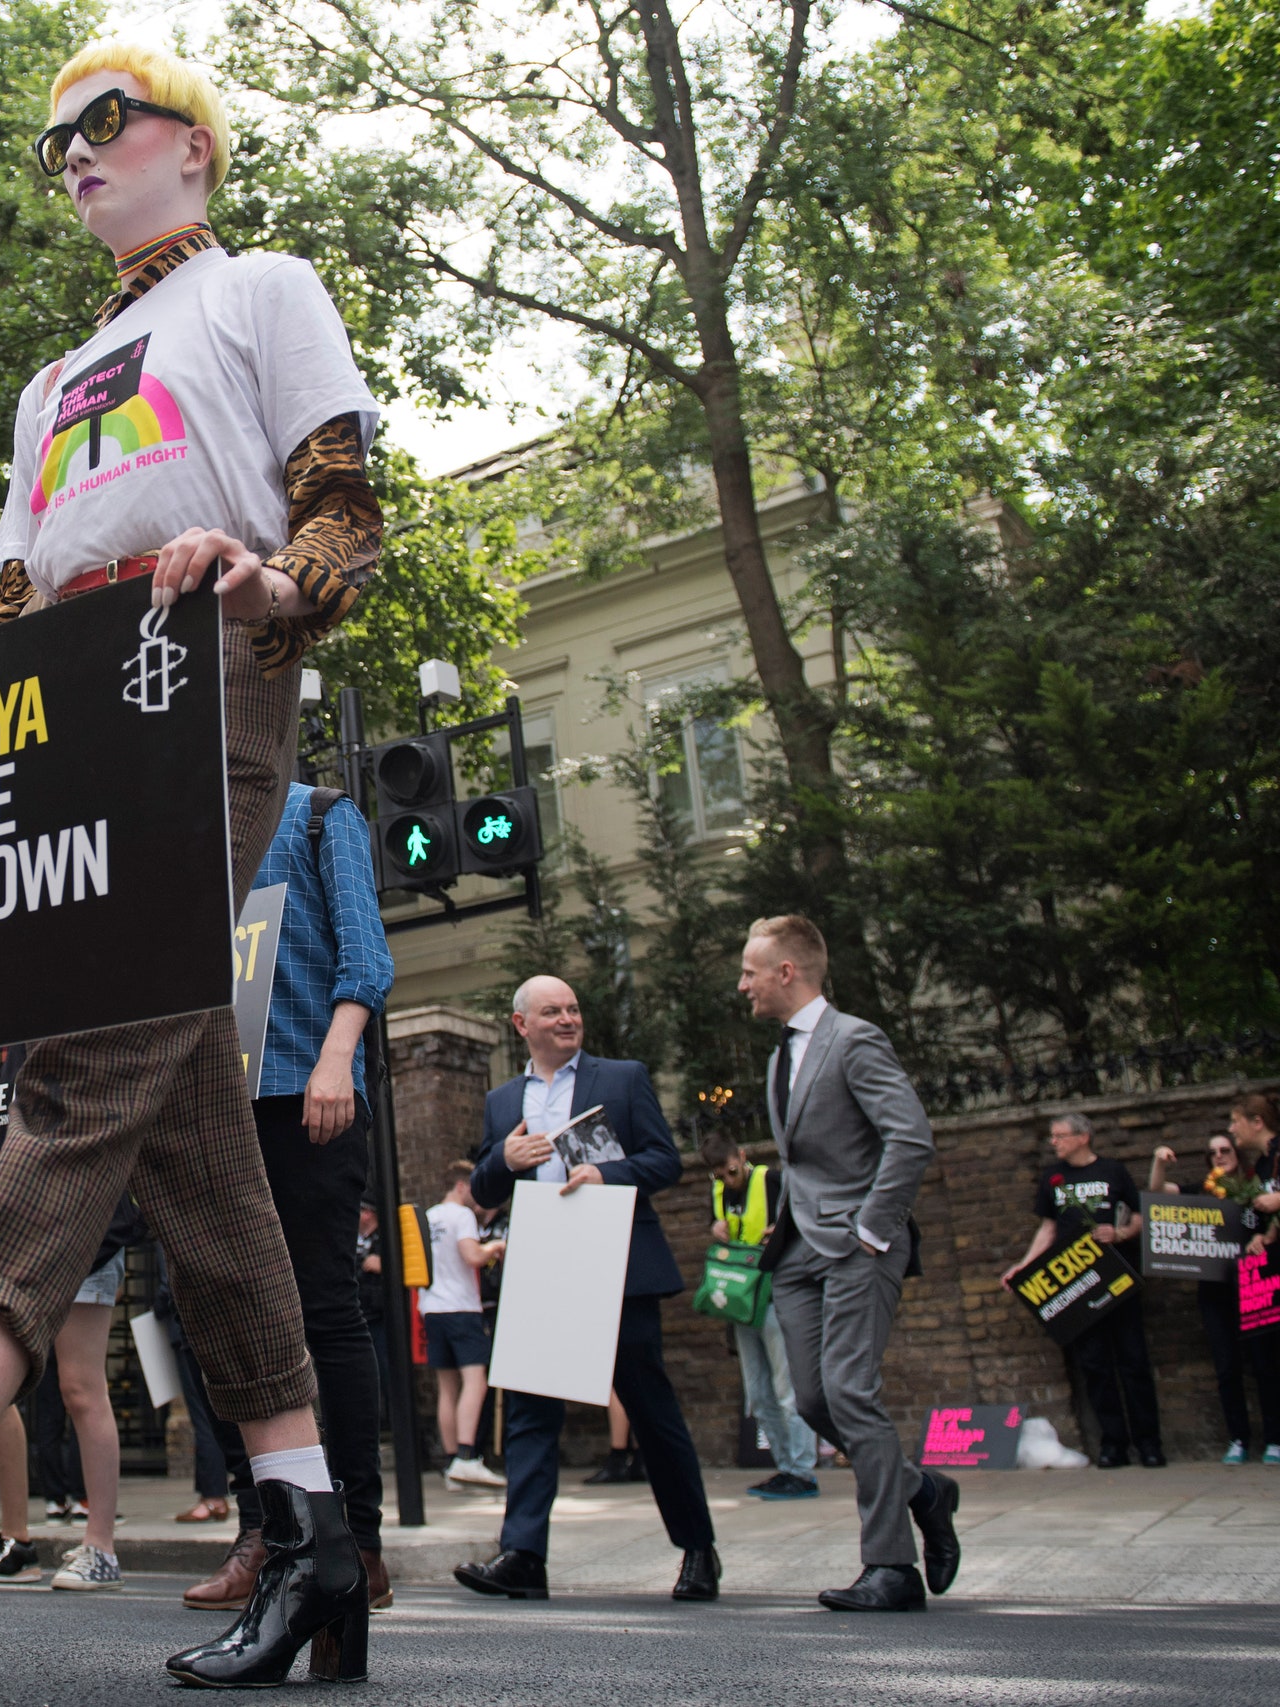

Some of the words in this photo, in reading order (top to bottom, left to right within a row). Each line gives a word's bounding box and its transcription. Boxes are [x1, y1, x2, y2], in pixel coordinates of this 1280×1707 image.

[63, 362, 126, 403] PROTECT
[58, 390, 108, 423] HUMAN
[62, 390, 86, 412] THE
[55, 493, 65, 509] IS
[67, 487, 76, 501] A
[79, 460, 131, 493] HUMAN
[135, 445, 188, 469] RIGHT
[1149, 1204, 1225, 1226] CHECHNYA
[1150, 1220, 1187, 1239] STOP
[1188, 1222, 1217, 1242] THE
[1150, 1237, 1241, 1259] CRACKDOWN
[1018, 1268, 1060, 1306] WE
[1047, 1231, 1104, 1286] EXIST
[930, 1407, 973, 1422] LOVE
